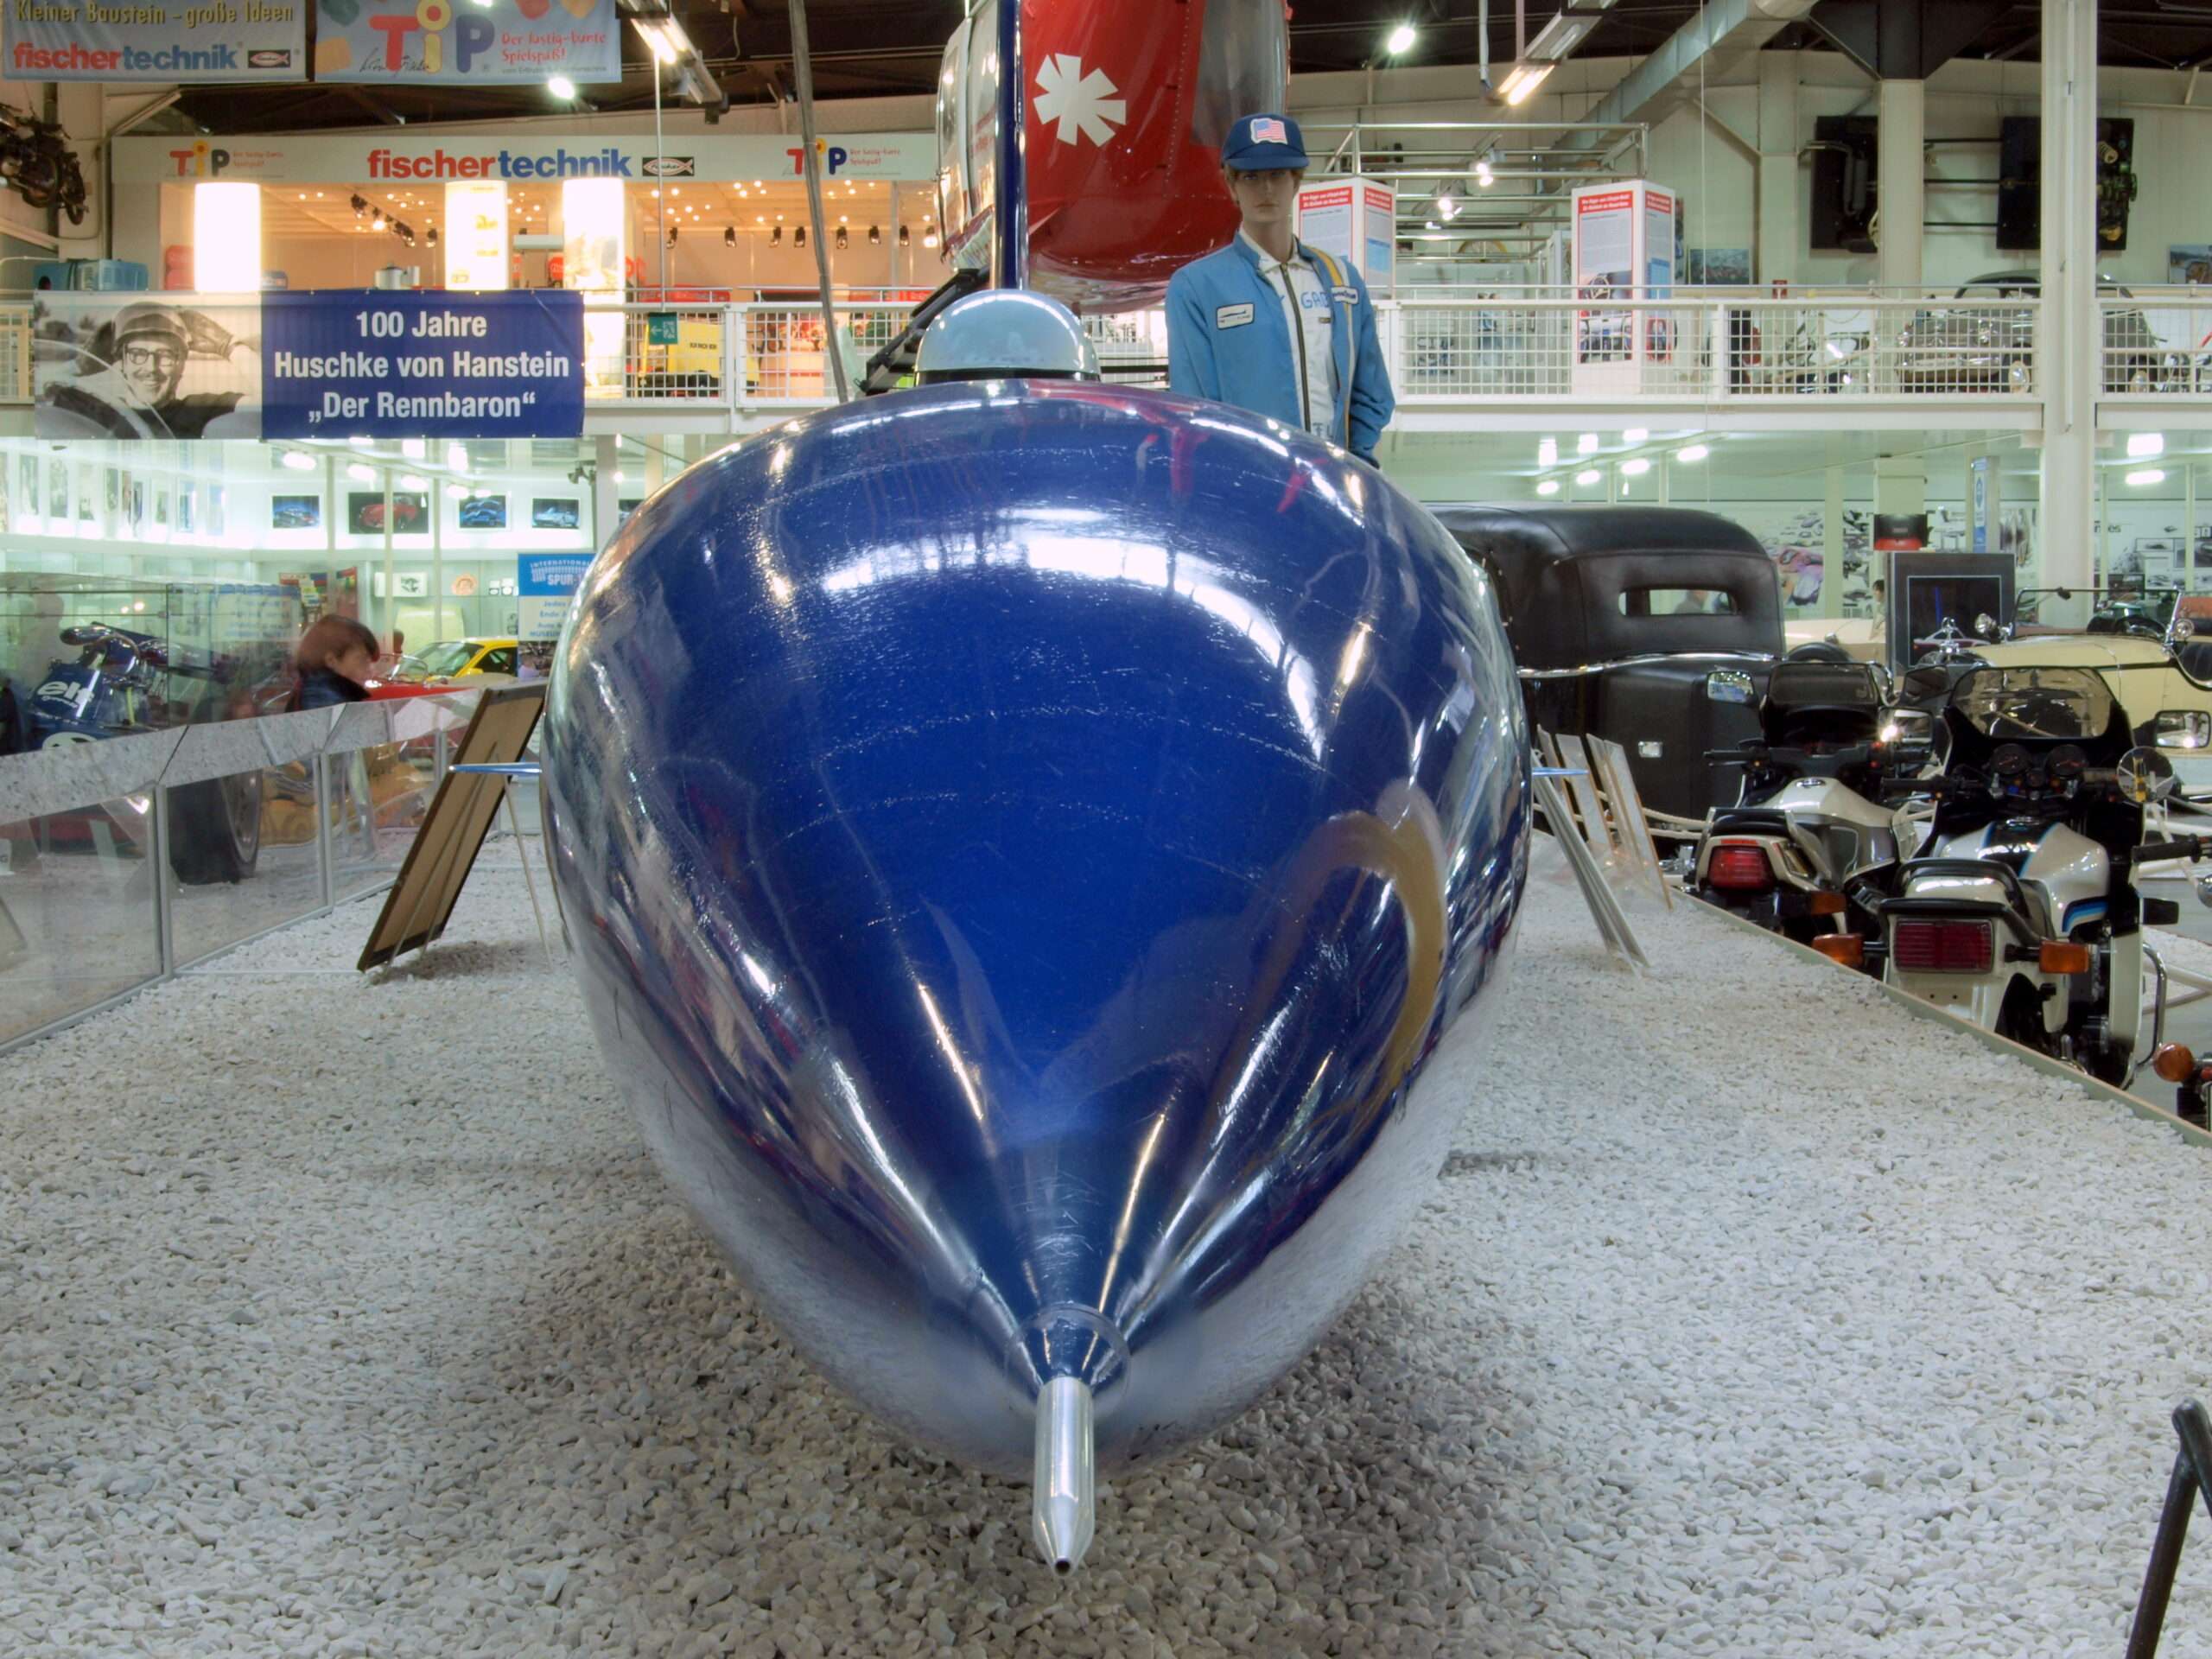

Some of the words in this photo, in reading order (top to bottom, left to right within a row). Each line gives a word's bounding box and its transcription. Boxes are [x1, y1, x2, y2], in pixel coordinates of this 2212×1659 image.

[15, 1, 79, 22] Kleiner
[87, 2, 166, 24] Baustein
[185, 2, 237, 29] große
[245, 1, 294, 22] Ideen
[501, 32, 522, 45] Der
[13, 41, 238, 71] fischertechnik
[366, 149, 632, 179] fischertechnik
[355, 310, 404, 338] 100
[411, 310, 488, 338] Jahre
[274, 351, 390, 378] Huschke
[396, 355, 445, 378] von
[453, 350, 569, 378] Hanstein
[308, 391, 370, 423] „Der
[377, 391, 537, 419] Rennbaron“
